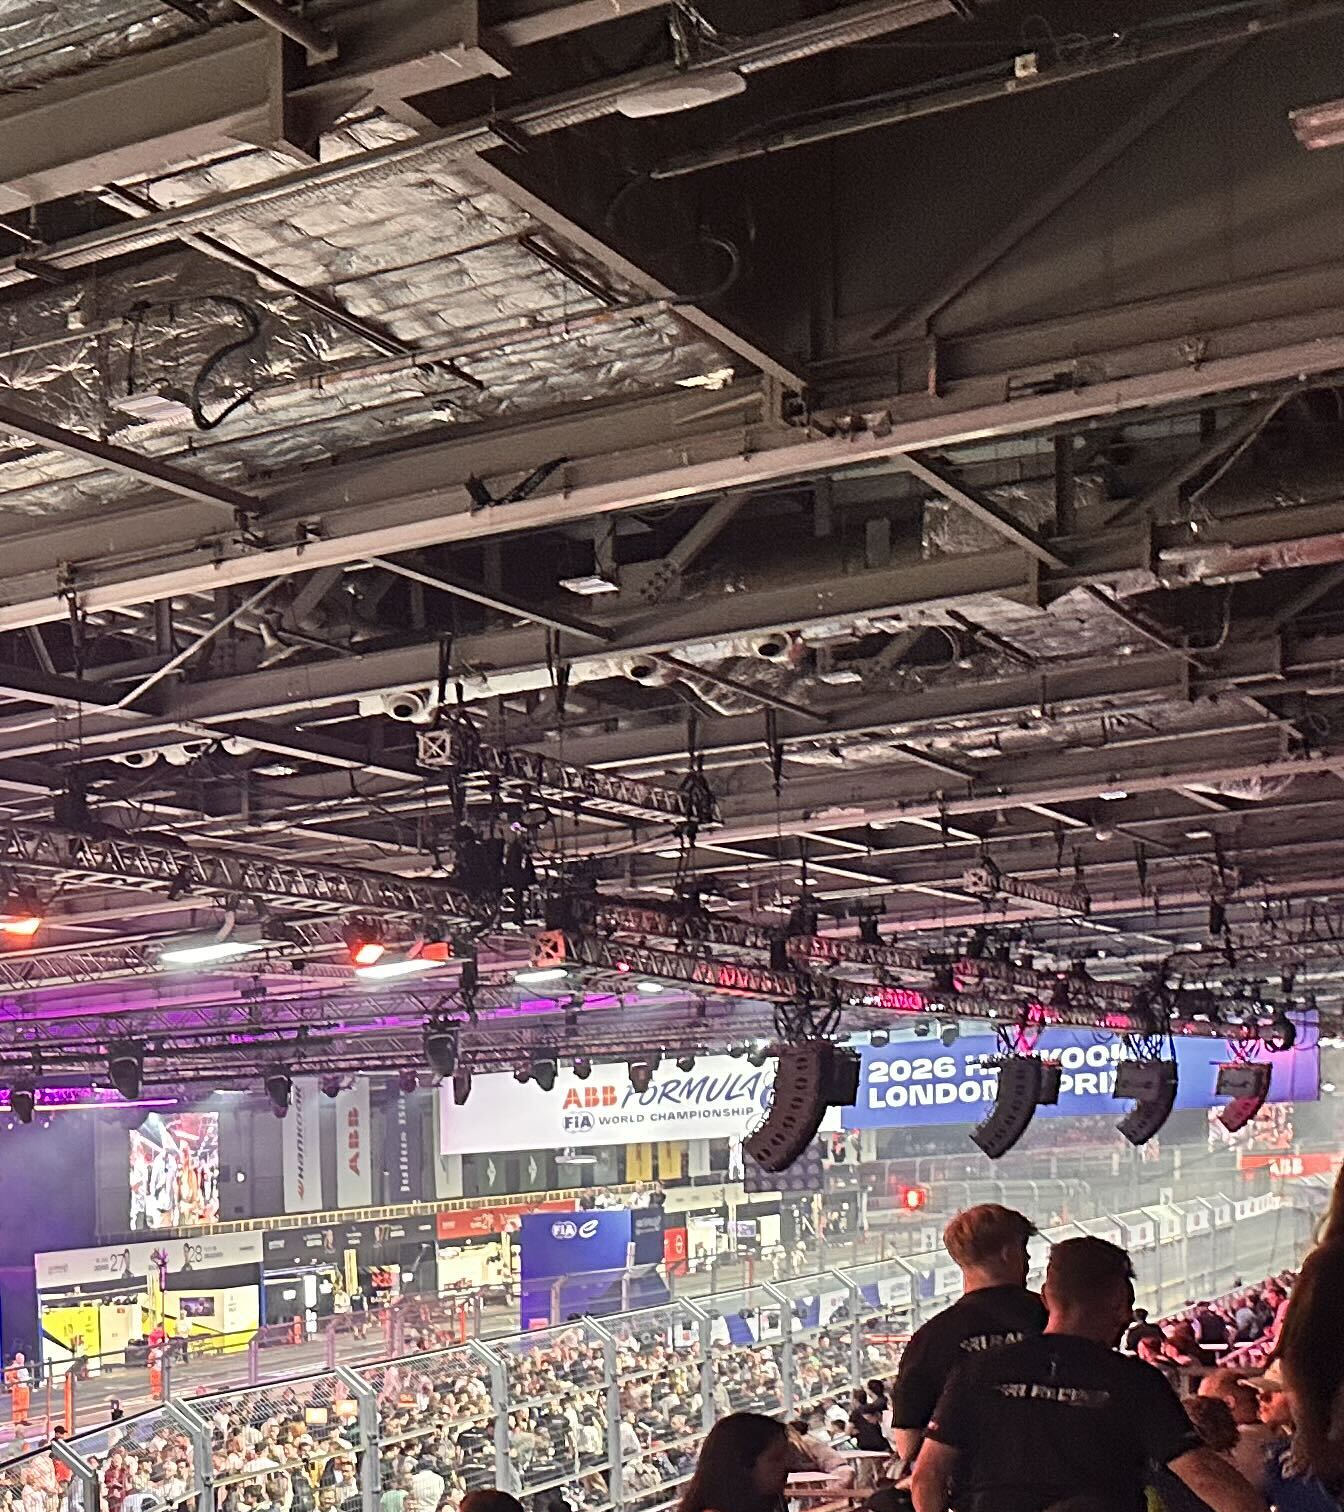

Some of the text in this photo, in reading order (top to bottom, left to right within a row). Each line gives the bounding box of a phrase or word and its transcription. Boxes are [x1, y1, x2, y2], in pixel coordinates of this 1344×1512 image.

[868, 1057, 957, 1083] 2026
[563, 1086, 617, 1109] ABB
[599, 1114, 645, 1125] WORLD
[650, 1107, 754, 1122] CHAMPIONSHIP
[348, 1107, 360, 1176] ABB
